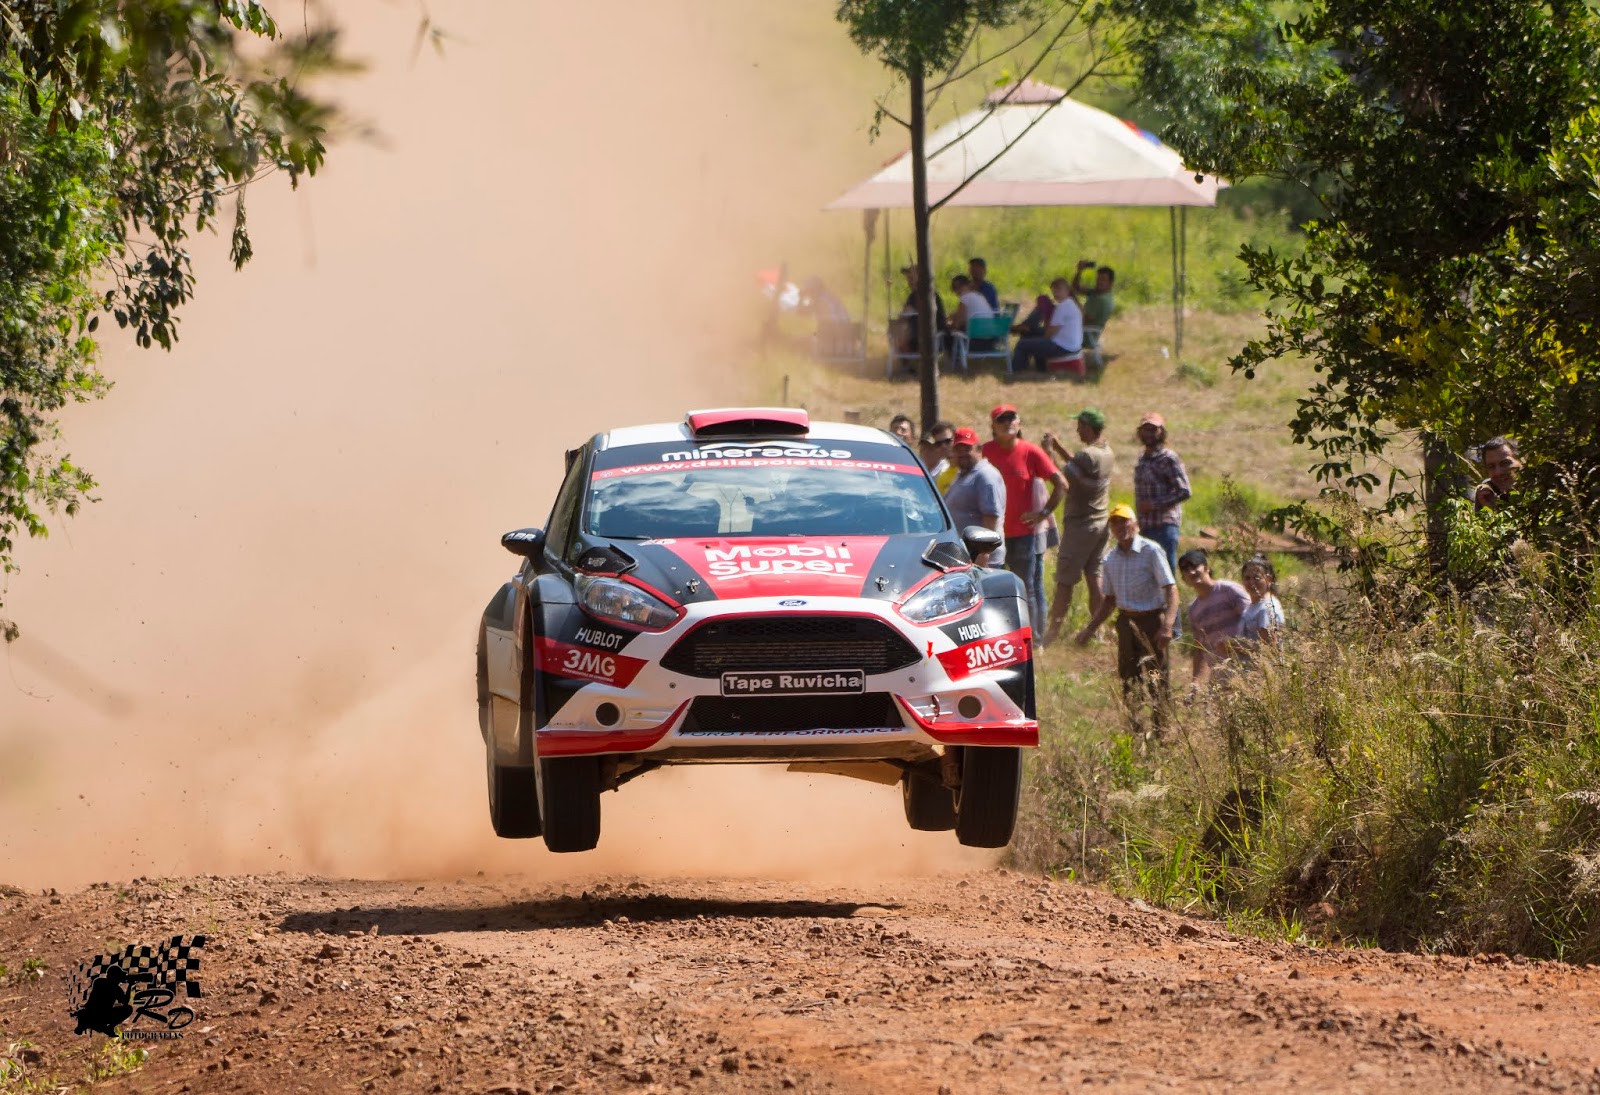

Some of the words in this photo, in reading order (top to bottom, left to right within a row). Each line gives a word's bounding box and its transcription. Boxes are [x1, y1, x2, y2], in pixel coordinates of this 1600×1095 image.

[704, 544, 851, 562] Mobil
[709, 559, 853, 575] Super
[575, 627, 623, 649] HUBLOT
[563, 649, 616, 677] 3MG
[965, 639, 1014, 669] 3MG
[726, 676, 773, 692] Tape
[779, 674, 861, 688] Ruvicha
